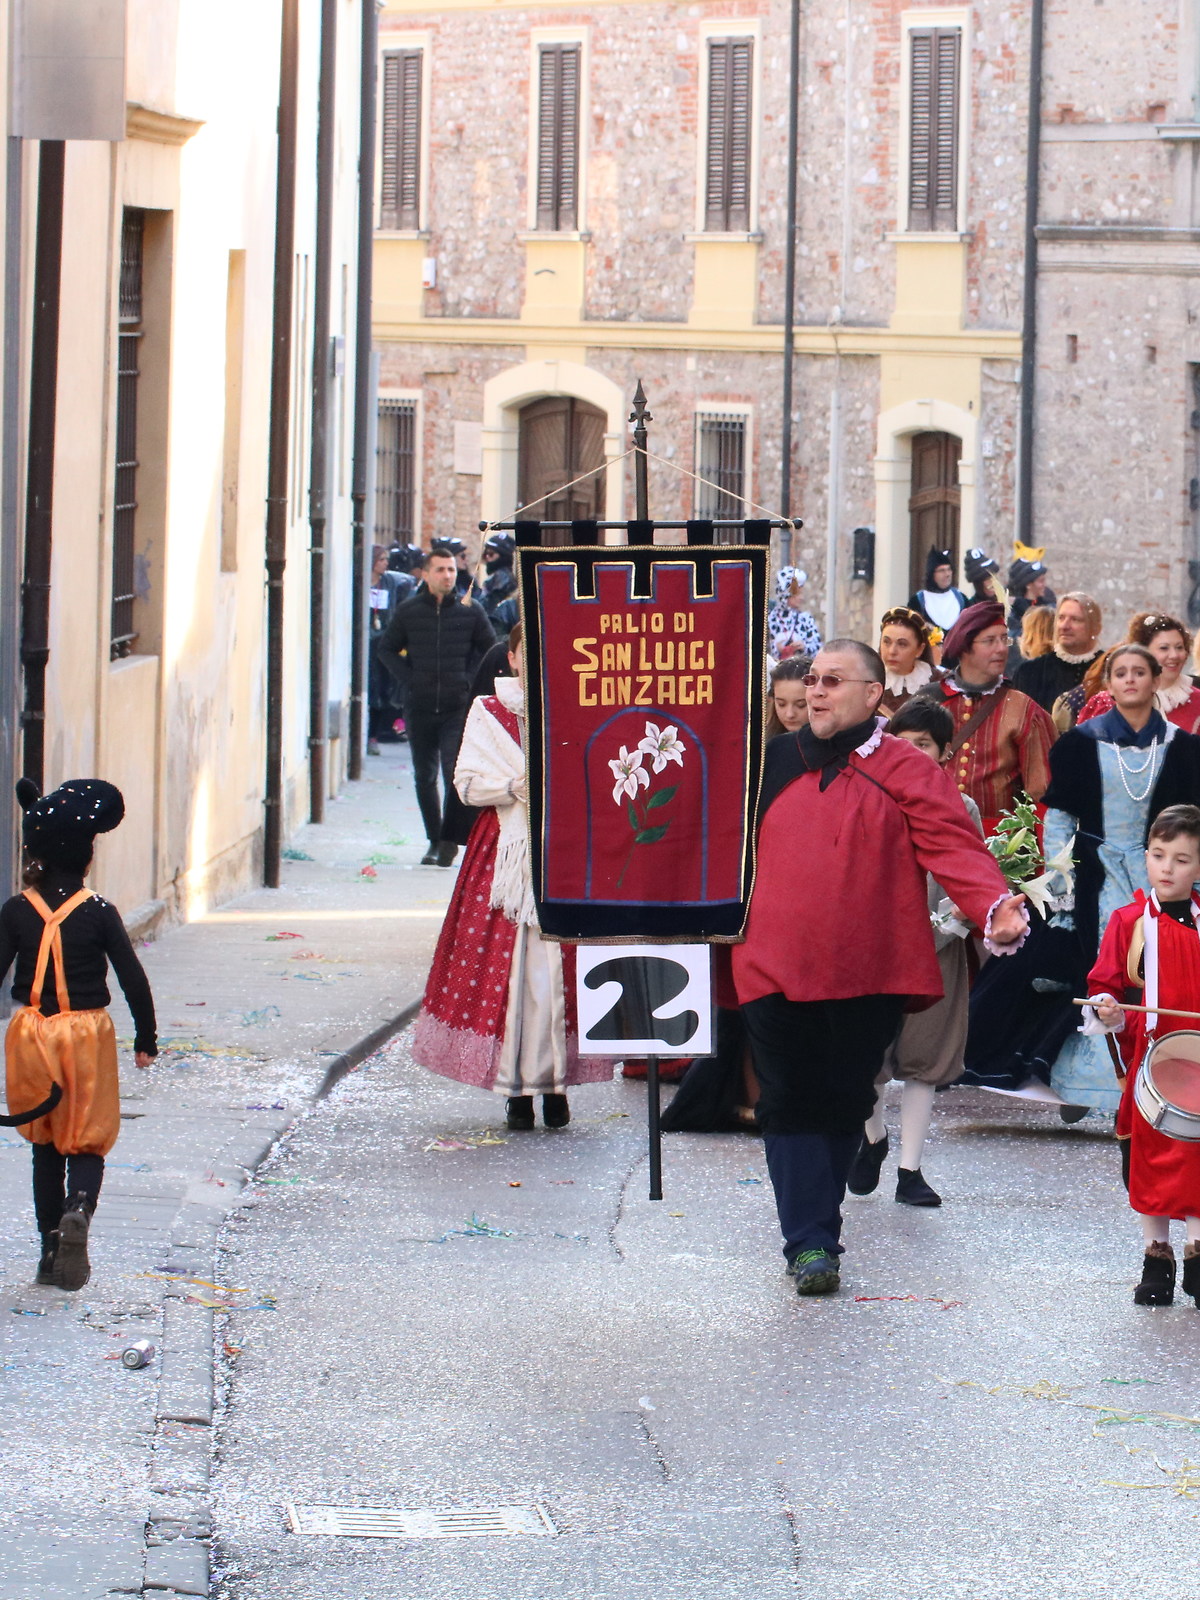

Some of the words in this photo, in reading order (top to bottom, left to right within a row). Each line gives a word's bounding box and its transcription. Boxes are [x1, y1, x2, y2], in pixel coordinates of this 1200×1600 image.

[600, 612, 664, 634] PALIO
[673, 612, 694, 633] DI
[571, 637, 632, 672] SAN
[638, 637, 715, 671] LUIGI
[578, 672, 713, 707] GONZAGA
[583, 955, 699, 1047] 2
